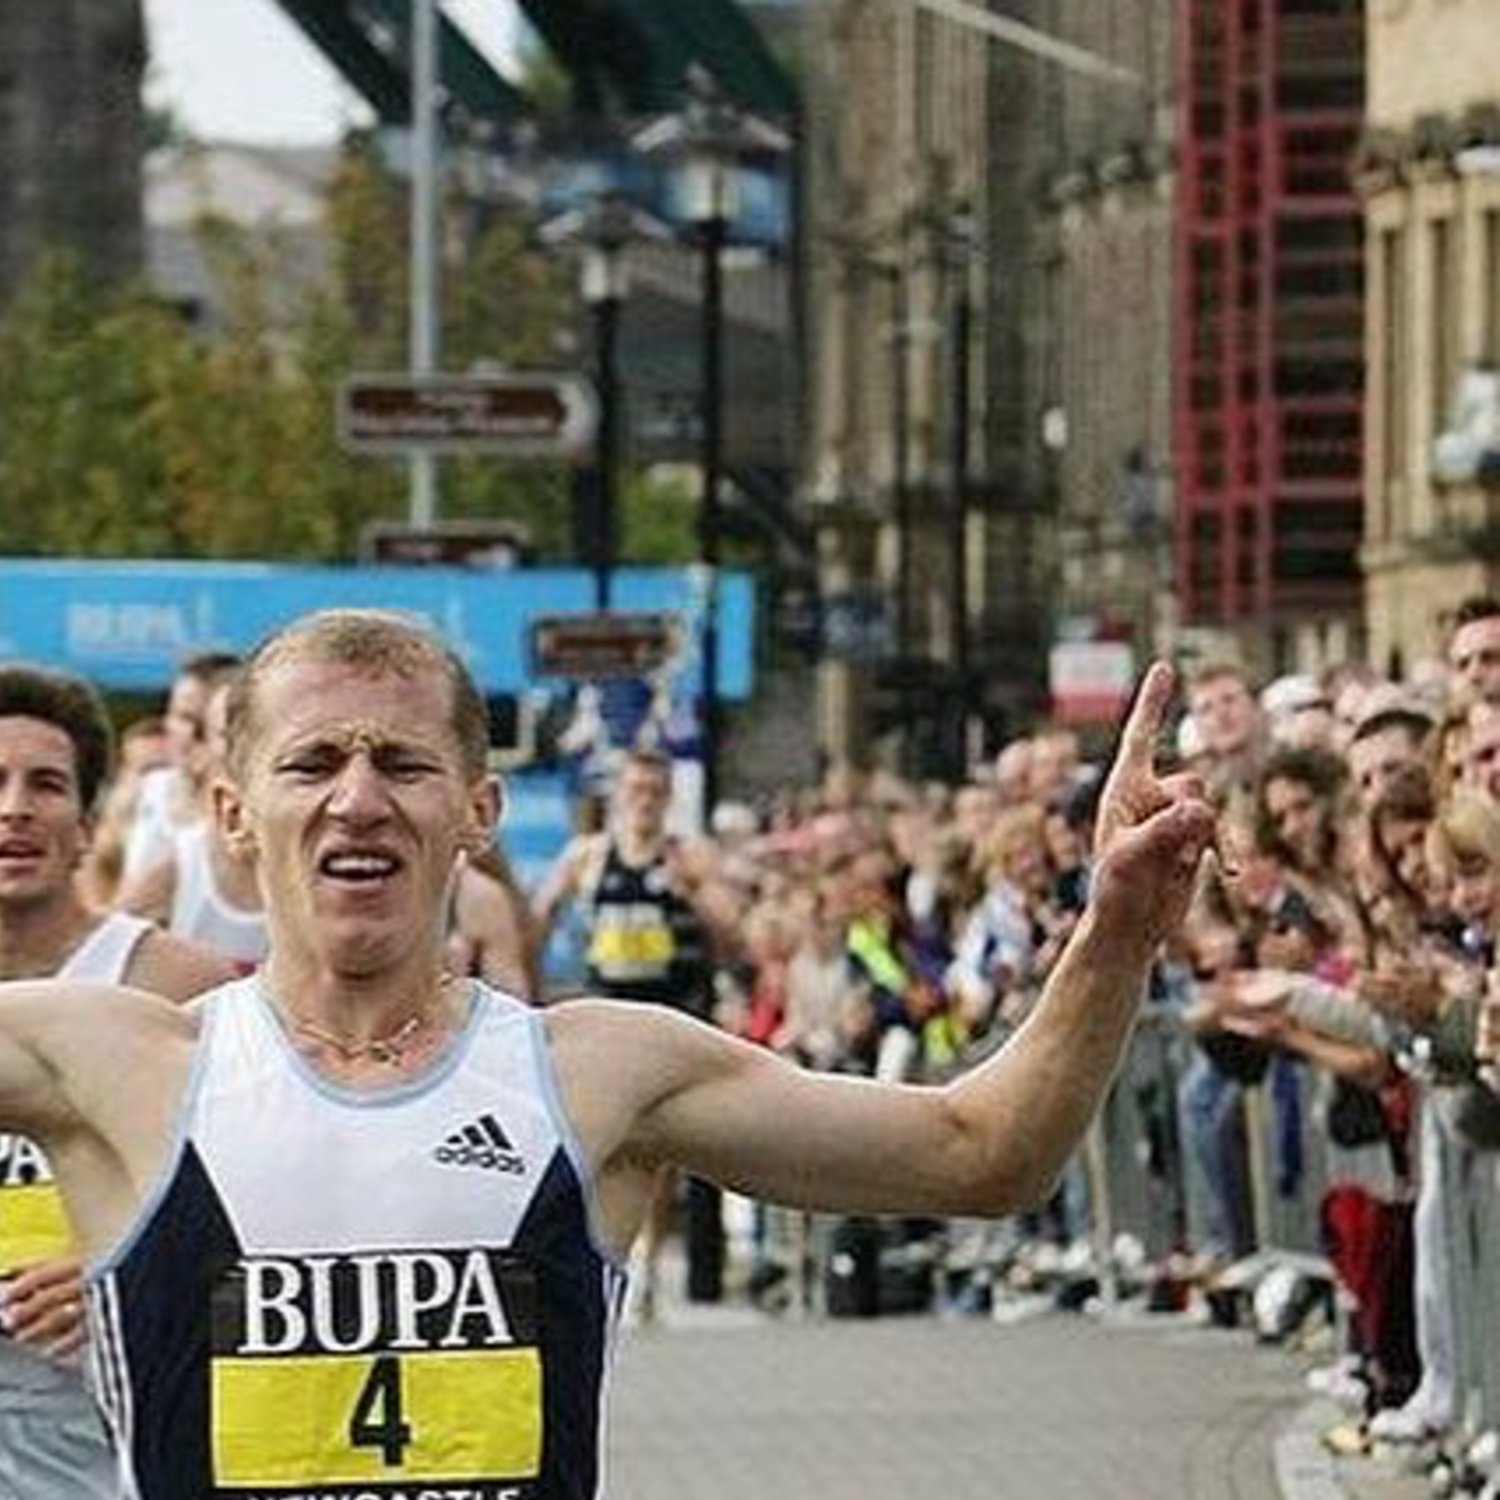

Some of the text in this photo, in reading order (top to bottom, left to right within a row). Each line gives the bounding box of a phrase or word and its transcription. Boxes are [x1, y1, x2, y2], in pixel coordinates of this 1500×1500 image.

[433, 1144, 527, 1176] adidas
[236, 1249, 514, 1354] BUPA
[351, 1355, 412, 1467] 4
